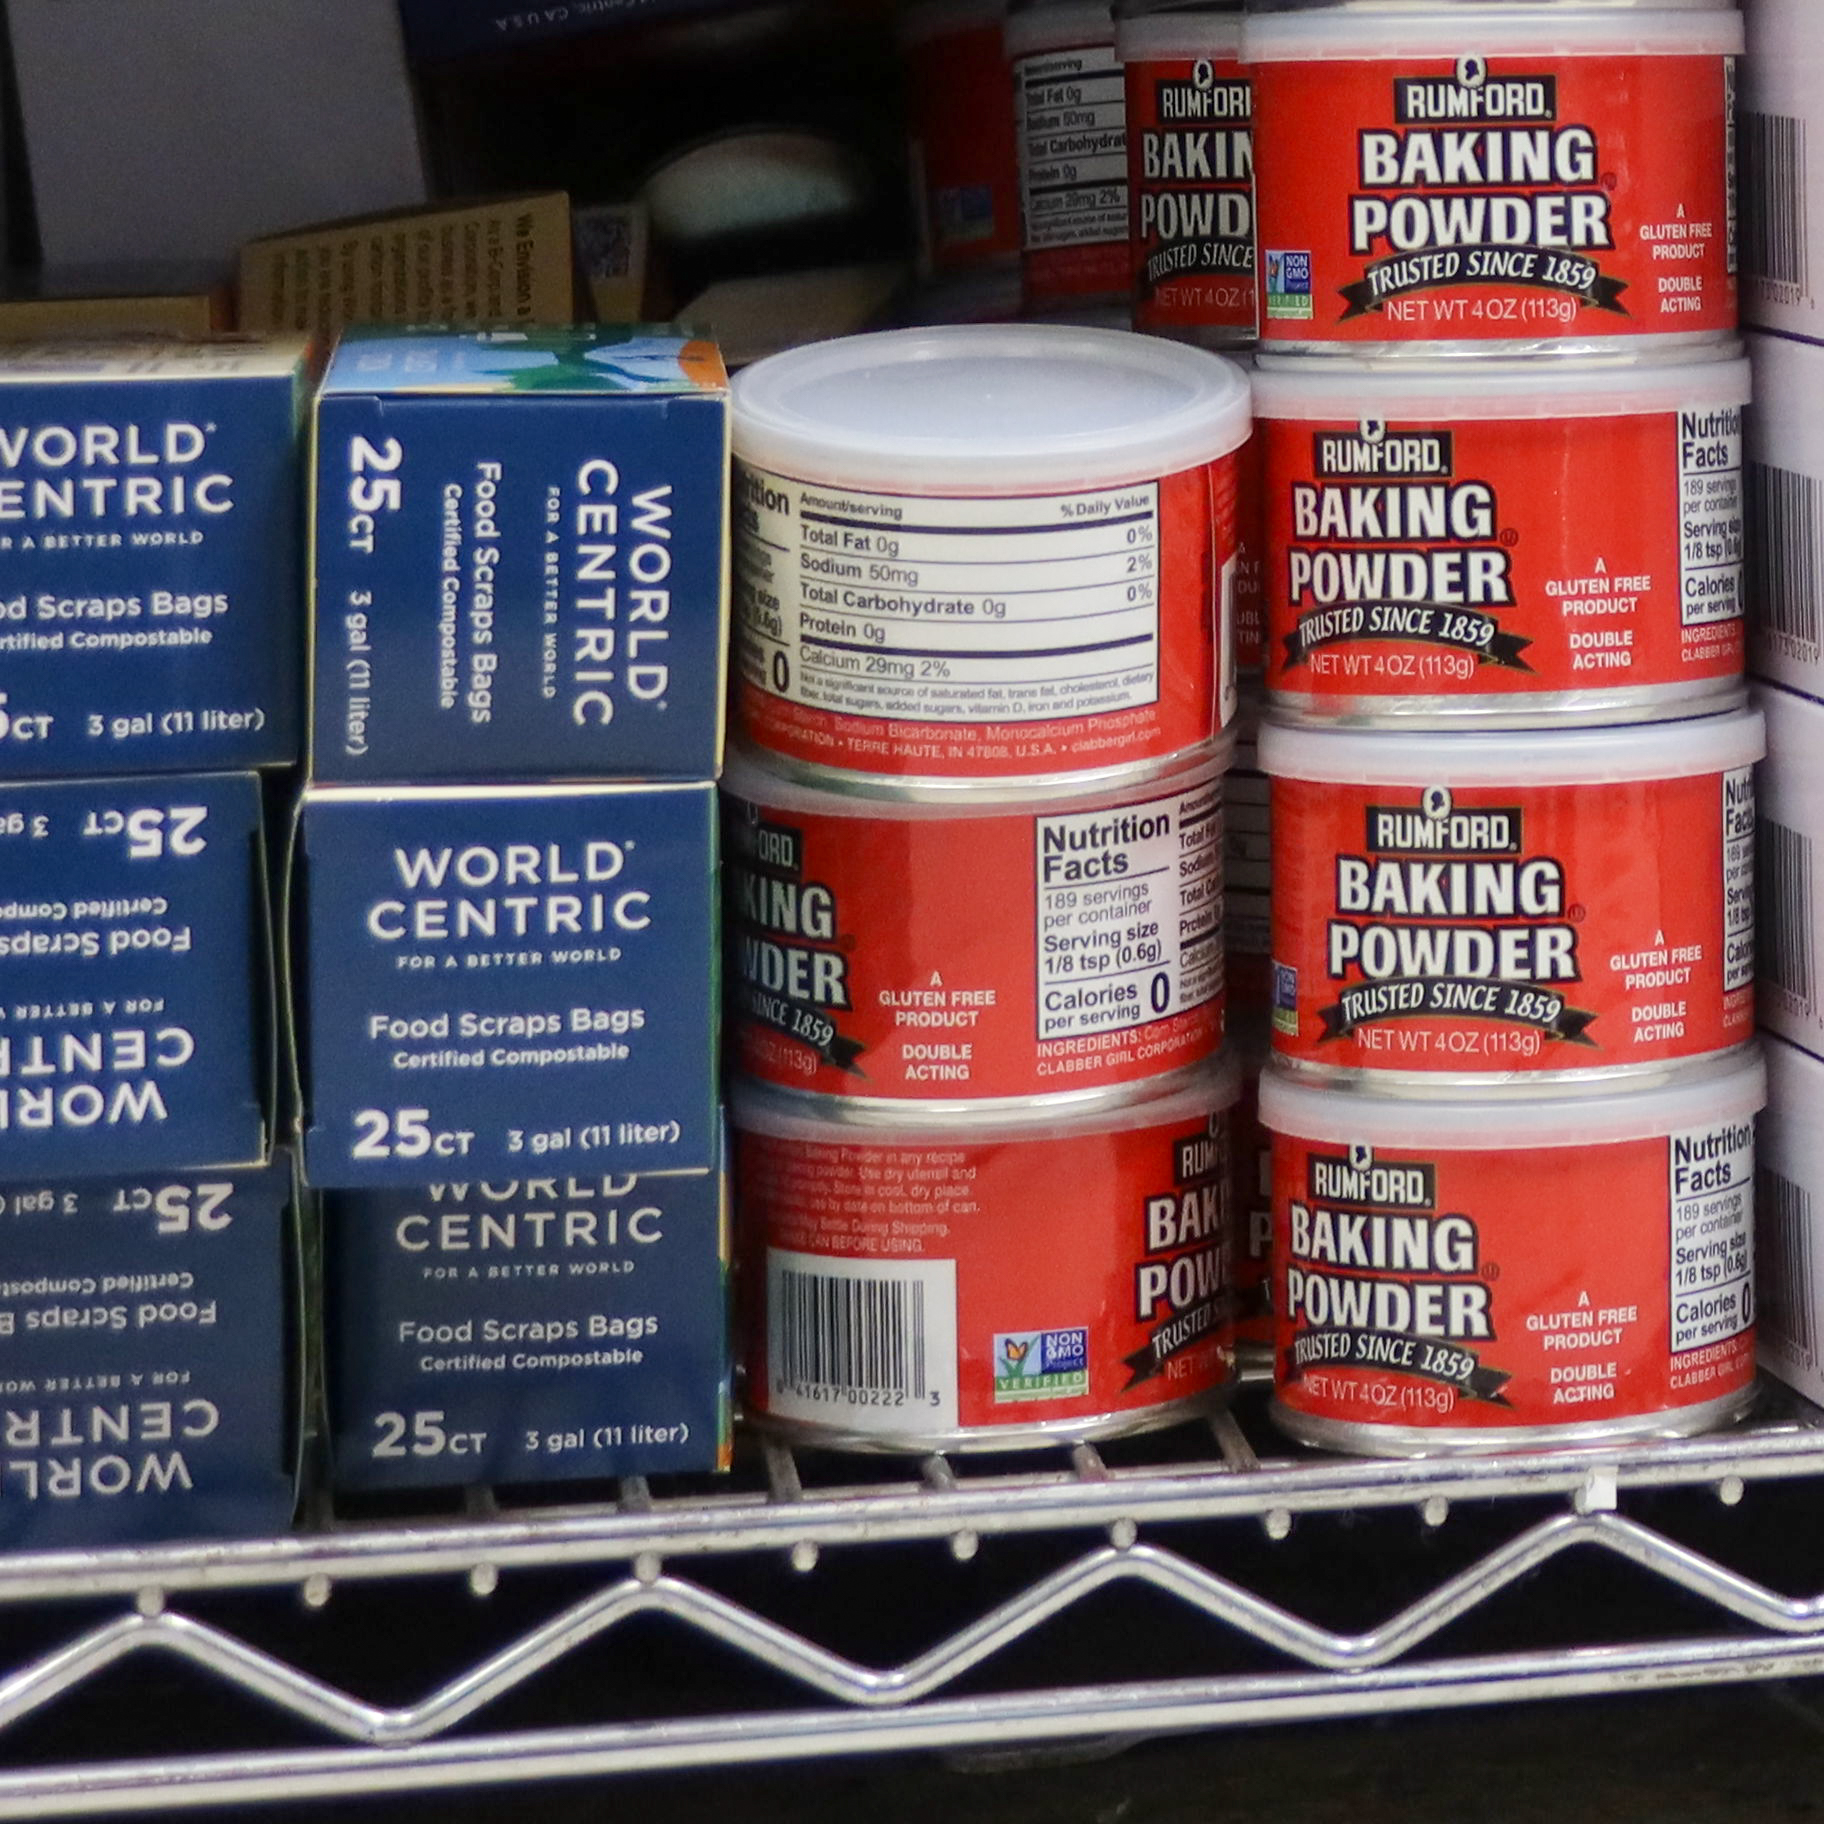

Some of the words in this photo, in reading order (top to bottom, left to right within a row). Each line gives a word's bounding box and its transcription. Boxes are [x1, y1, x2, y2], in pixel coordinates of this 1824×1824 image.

[573, 459, 621, 726] CENTRIC
[626, 483, 674, 702] WORLD
[1043, 810, 1171, 857] Nutrition
[394, 840, 626, 890] WORLD
[1043, 849, 1129, 883] Facts
[1044, 892, 1077, 911] 189
[1081, 882, 1149, 909] servings
[367, 891, 652, 941] CENTRIC
[1044, 911, 1073, 931] per
[1078, 899, 1153, 925] container
[1044, 981, 1137, 1013] Calories
[370, 1011, 450, 1040] Food
[459, 1011, 562, 1038] Scraps
[570, 1005, 646, 1034] Bags
[393, 1045, 485, 1069] Certified
[491, 1042, 630, 1068] Compostable
